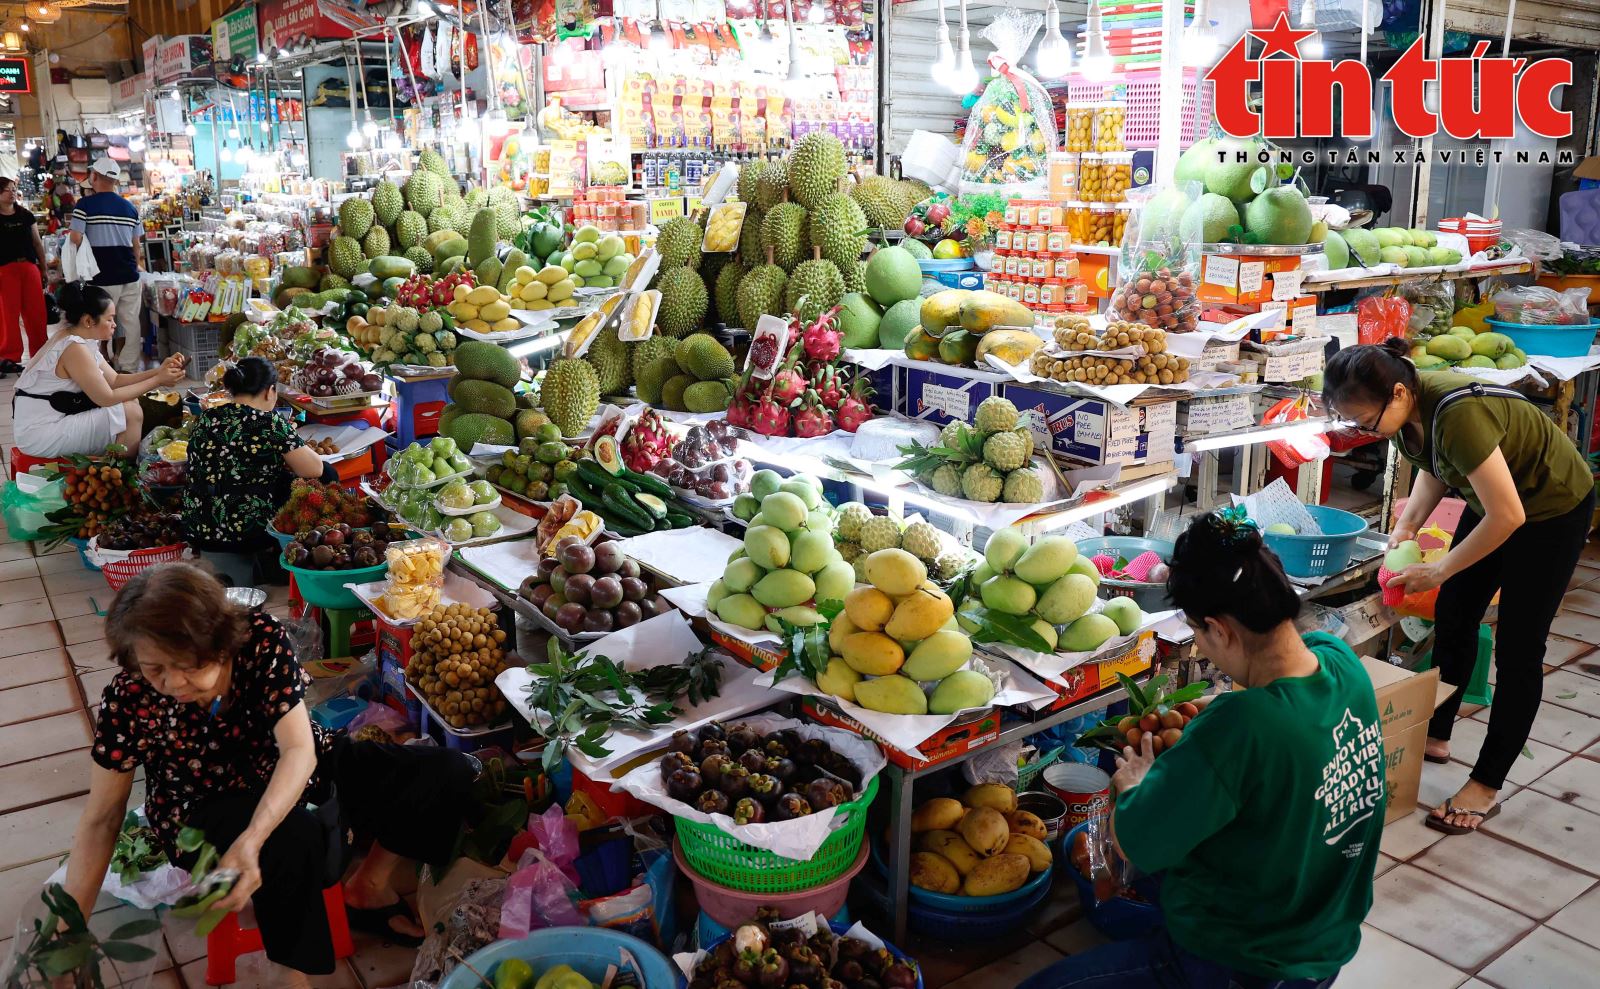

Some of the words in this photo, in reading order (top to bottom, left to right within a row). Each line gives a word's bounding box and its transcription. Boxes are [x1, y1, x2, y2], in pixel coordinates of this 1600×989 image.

[1076, 421, 1092, 430] FREE
[1077, 413, 1088, 421] NO
[1314, 761, 1352, 800] GOOD
[1352, 739, 1380, 765] VIB
[1322, 738, 1356, 780] ENJOY
[1324, 765, 1366, 808] READY
[1330, 784, 1364, 817] STAY
[1323, 811, 1347, 836] ALL
